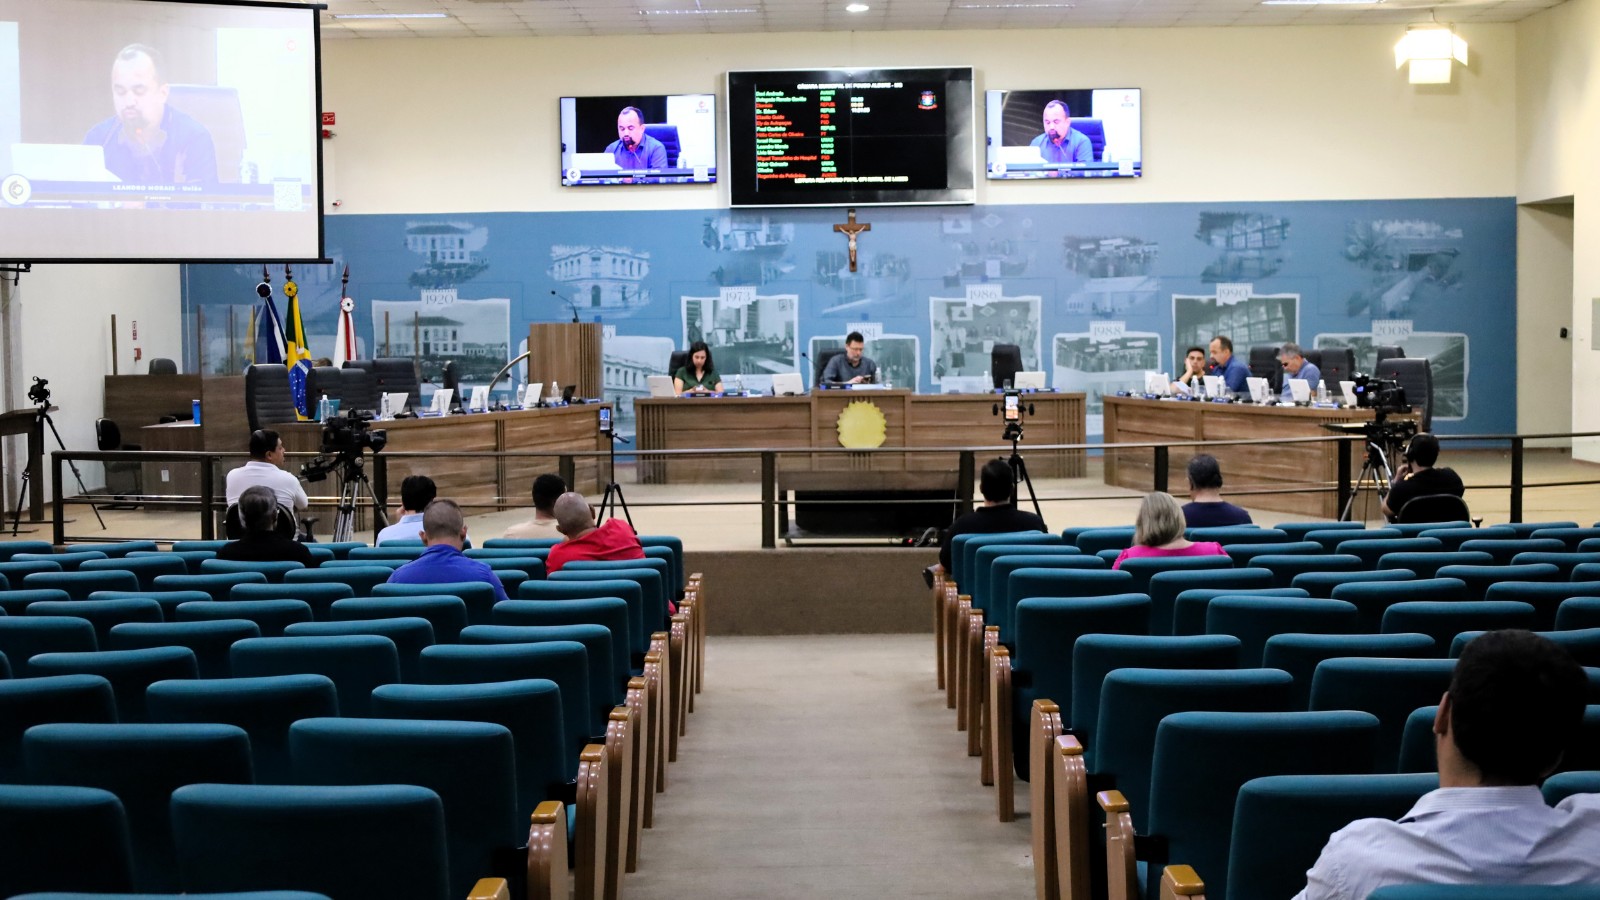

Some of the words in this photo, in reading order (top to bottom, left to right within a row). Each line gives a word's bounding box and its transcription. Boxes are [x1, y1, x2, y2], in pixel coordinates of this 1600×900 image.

[726, 291, 751, 302] 1973
[969, 289, 997, 300] 1986
[1219, 287, 1249, 298] 1990
[425, 294, 454, 305] 1920
[1094, 325, 1122, 337] 1988
[1375, 325, 1410, 337] 2008
